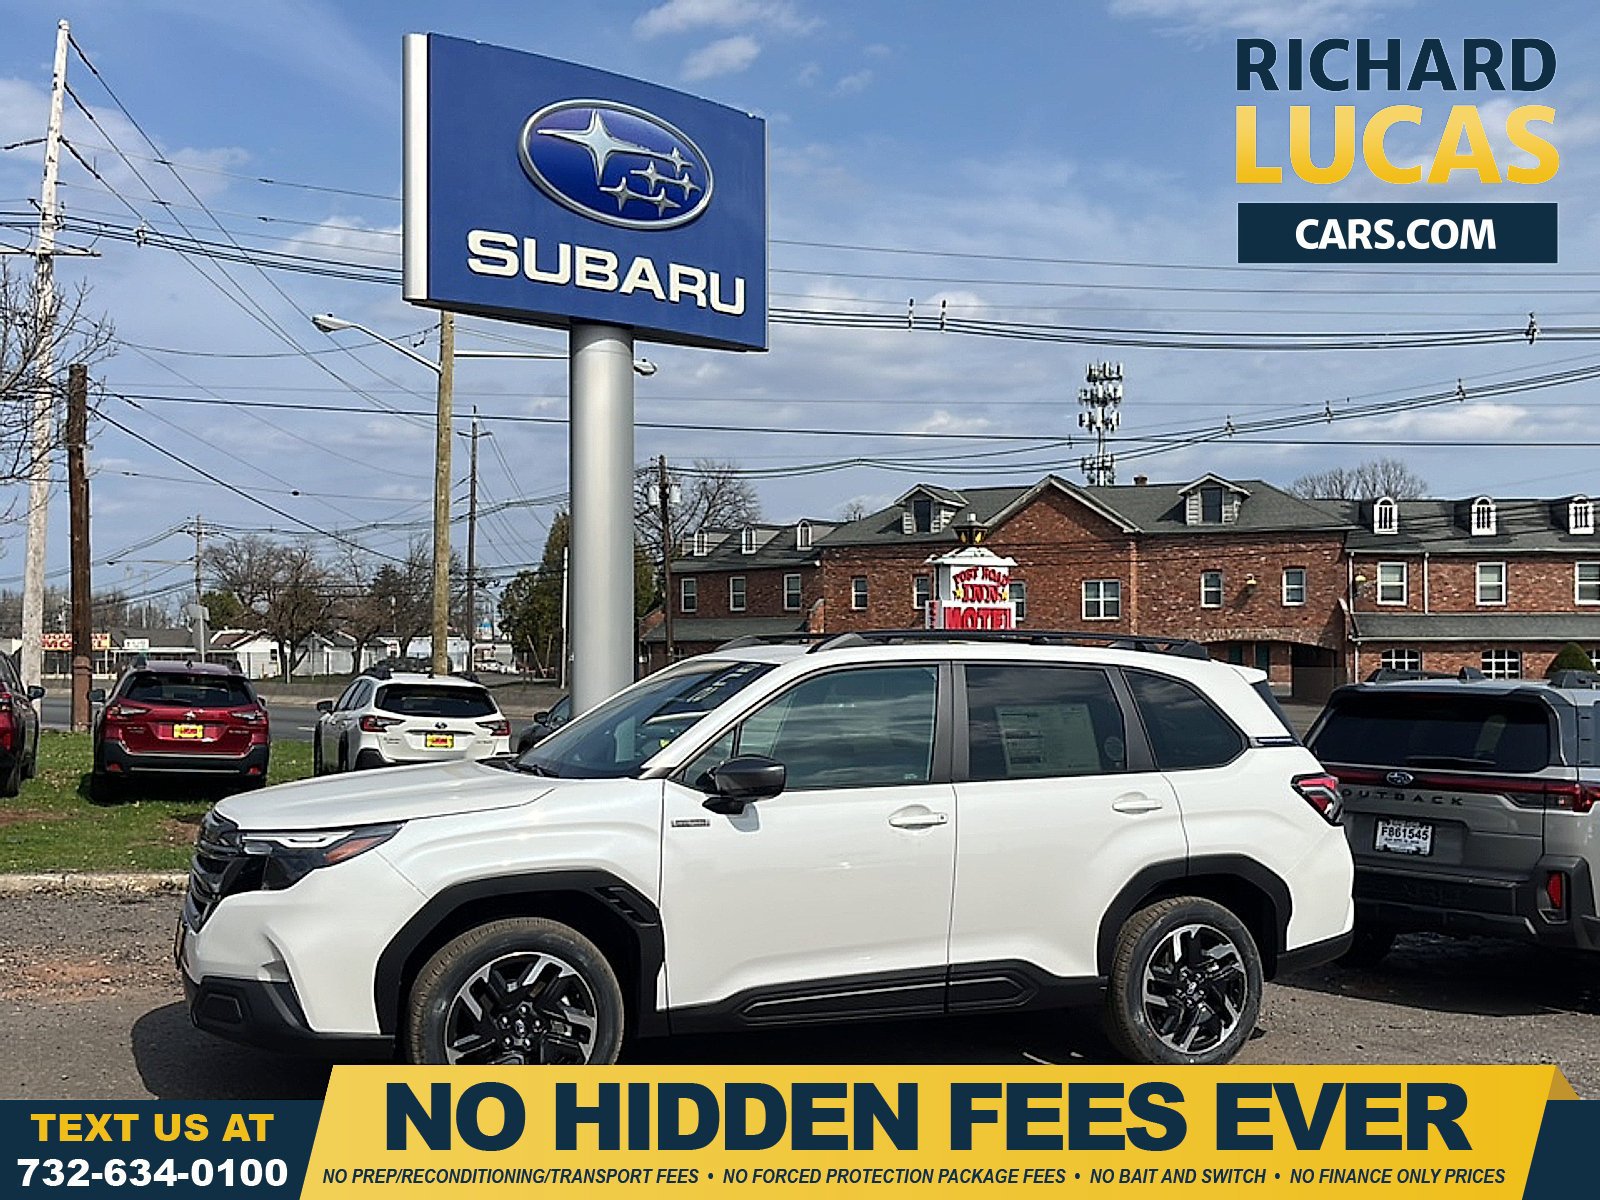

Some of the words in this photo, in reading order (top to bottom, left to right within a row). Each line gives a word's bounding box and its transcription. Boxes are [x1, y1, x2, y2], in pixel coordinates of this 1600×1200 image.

[466, 229, 745, 316] SUBARU
[962, 583, 1000, 602] INN
[944, 607, 1011, 630] MOTEL
[1341, 788, 1463, 806] OUTBACK
